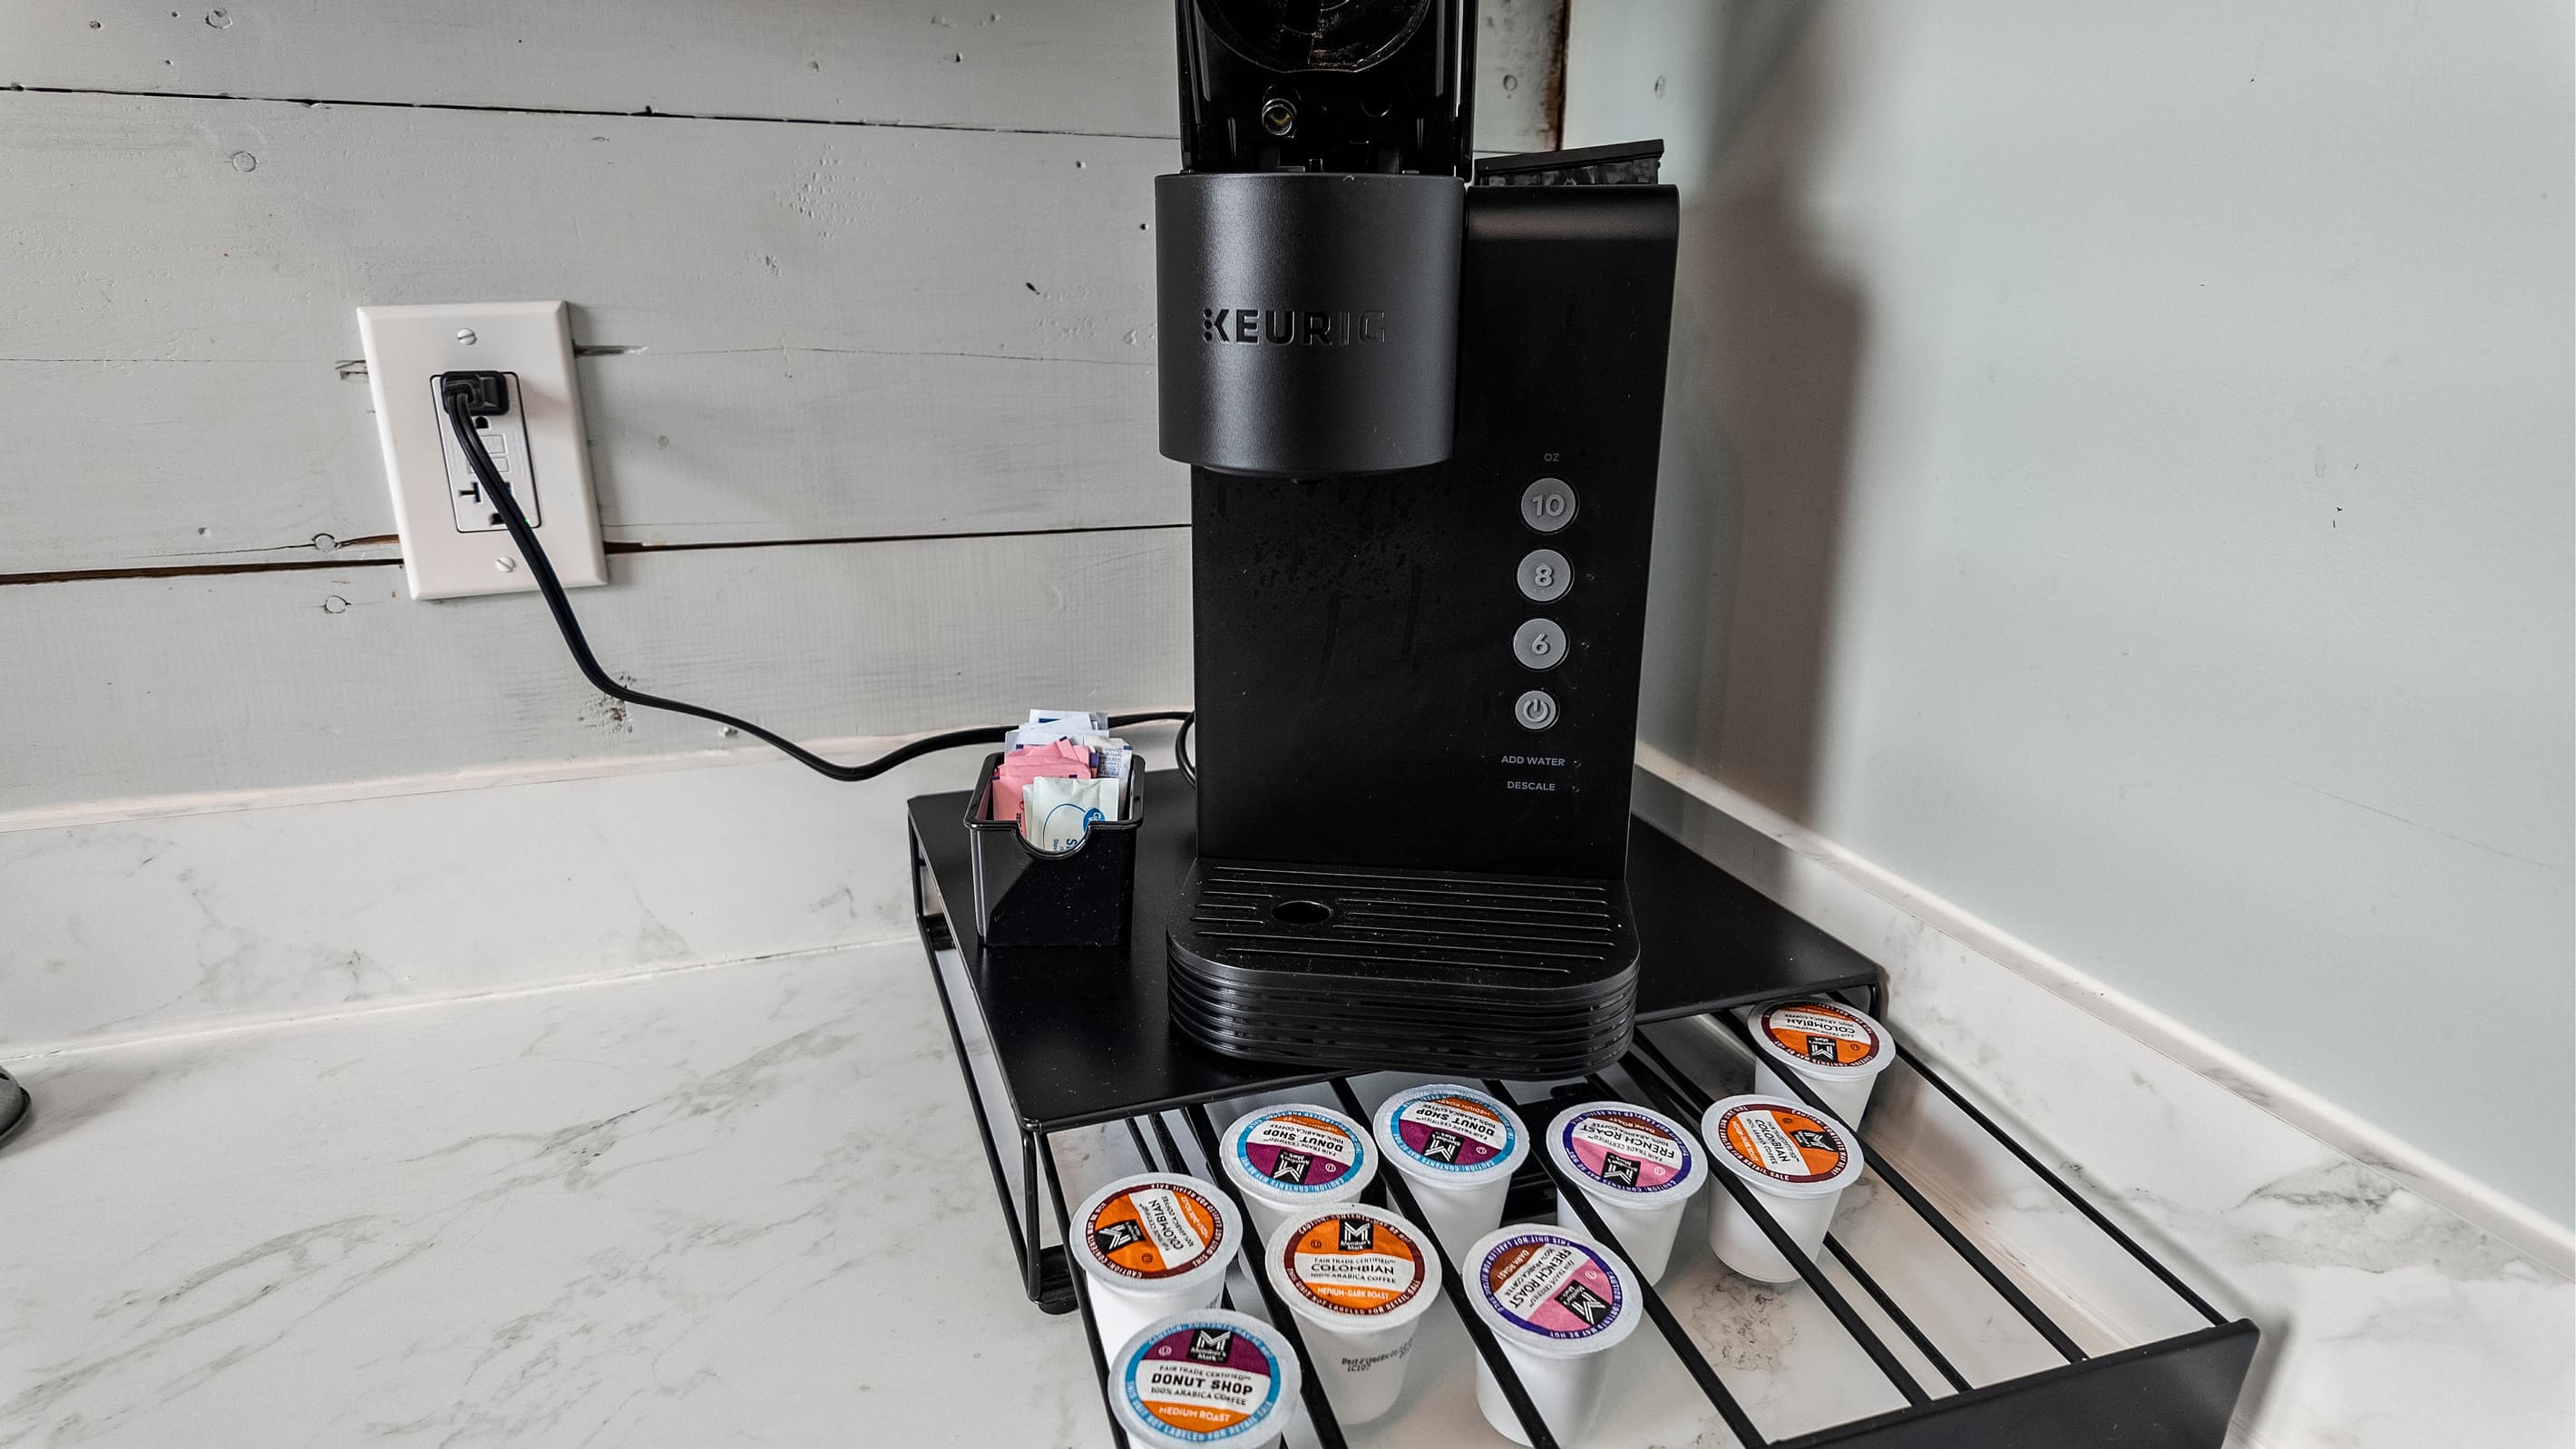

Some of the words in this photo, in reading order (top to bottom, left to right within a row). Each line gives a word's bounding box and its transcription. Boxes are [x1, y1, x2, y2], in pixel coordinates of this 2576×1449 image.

[1203, 308, 1386, 346] KEURIG
[1544, 453, 1560, 462] OZ
[1531, 494, 1566, 516] 10
[1535, 564, 1554, 587] 8
[1531, 633, 1550, 655] 6
[1501, 755, 1525, 765] ADD
[1527, 757, 1566, 767] WATER
[1507, 780, 1556, 791] DESCALE
[1787, 1019, 1855, 1033] COLOMBIAN
[1422, 1104, 1448, 1112] COFFEE
[1460, 1104, 1490, 1116] MEDIUM
[1416, 1109, 1449, 1121] SHOP
[1449, 1110, 1478, 1121] ARABICA
[1624, 1112, 1655, 1124] LABELED
[1452, 1118, 1495, 1136] DONUT
[1479, 1119, 1496, 1129] 100%
[1592, 1122, 1618, 1131] COFFEE
[1609, 1117, 1634, 1128] ROAST
[1634, 1123, 1655, 1133] DARK
[1263, 1129, 1296, 1141] SHOP
[1296, 1128, 1324, 1138] ARABICA
[1473, 1132, 1488, 1141] FAIR
[1580, 1125, 1622, 1140] ROAST
[1620, 1130, 1649, 1140] ARABICA
[1300, 1136, 1343, 1152] DONUT
[1328, 1135, 1344, 1144] 100%
[1651, 1138, 1669, 1147] 100%
[1755, 1119, 1791, 1162] COLOMBIAN
[1625, 1136, 1674, 1159] FRENCH
[1626, 1145, 1646, 1155] TRADE
[1648, 1153, 1663, 1161] FAIR
[1764, 1145, 1778, 1165] COFFEE
[1422, 1160, 1459, 1171] CONTENTS
[1742, 1159, 1768, 1175] RETAIL
[1770, 1171, 1790, 1181] SALE
[1173, 1185, 1196, 1198] RETAIL
[1148, 1199, 1184, 1249] COLOMBIAN
[1514, 1237, 1528, 1246] NOT
[1552, 1238, 1570, 1247] THIS
[1488, 1241, 1513, 1260] LABELED
[1192, 1254, 1208, 1268] THIS
[1514, 1249, 1529, 1267] DARK
[1107, 1259, 1142, 1278] CAUTION:
[1311, 1264, 1394, 1275] COLOMBIAN
[1497, 1262, 1516, 1280] ROAST
[1536, 1249, 1572, 1282] FRENCH
[1367, 1276, 1396, 1284] COFFEE
[1552, 1269, 1566, 1285] TRADE
[1367, 1290, 1389, 1300] ROAST
[1509, 1279, 1540, 1308] ROAST
[1368, 1306, 1384, 1314] FOR
[1583, 1327, 1597, 1336] MAY
[1179, 1366, 1204, 1376] TRADE
[1151, 1373, 1205, 1387] DONUT
[1211, 1379, 1254, 1395] SHOP
[1150, 1386, 1172, 1395] 100%
[1174, 1389, 1212, 1399] ARABICA
[1214, 1393, 1247, 1405] COFFEE
[1158, 1406, 1197, 1418] MEDIUM
[1198, 1410, 1231, 1423] ROAST
[1229, 1415, 1257, 1434] RETAIL
